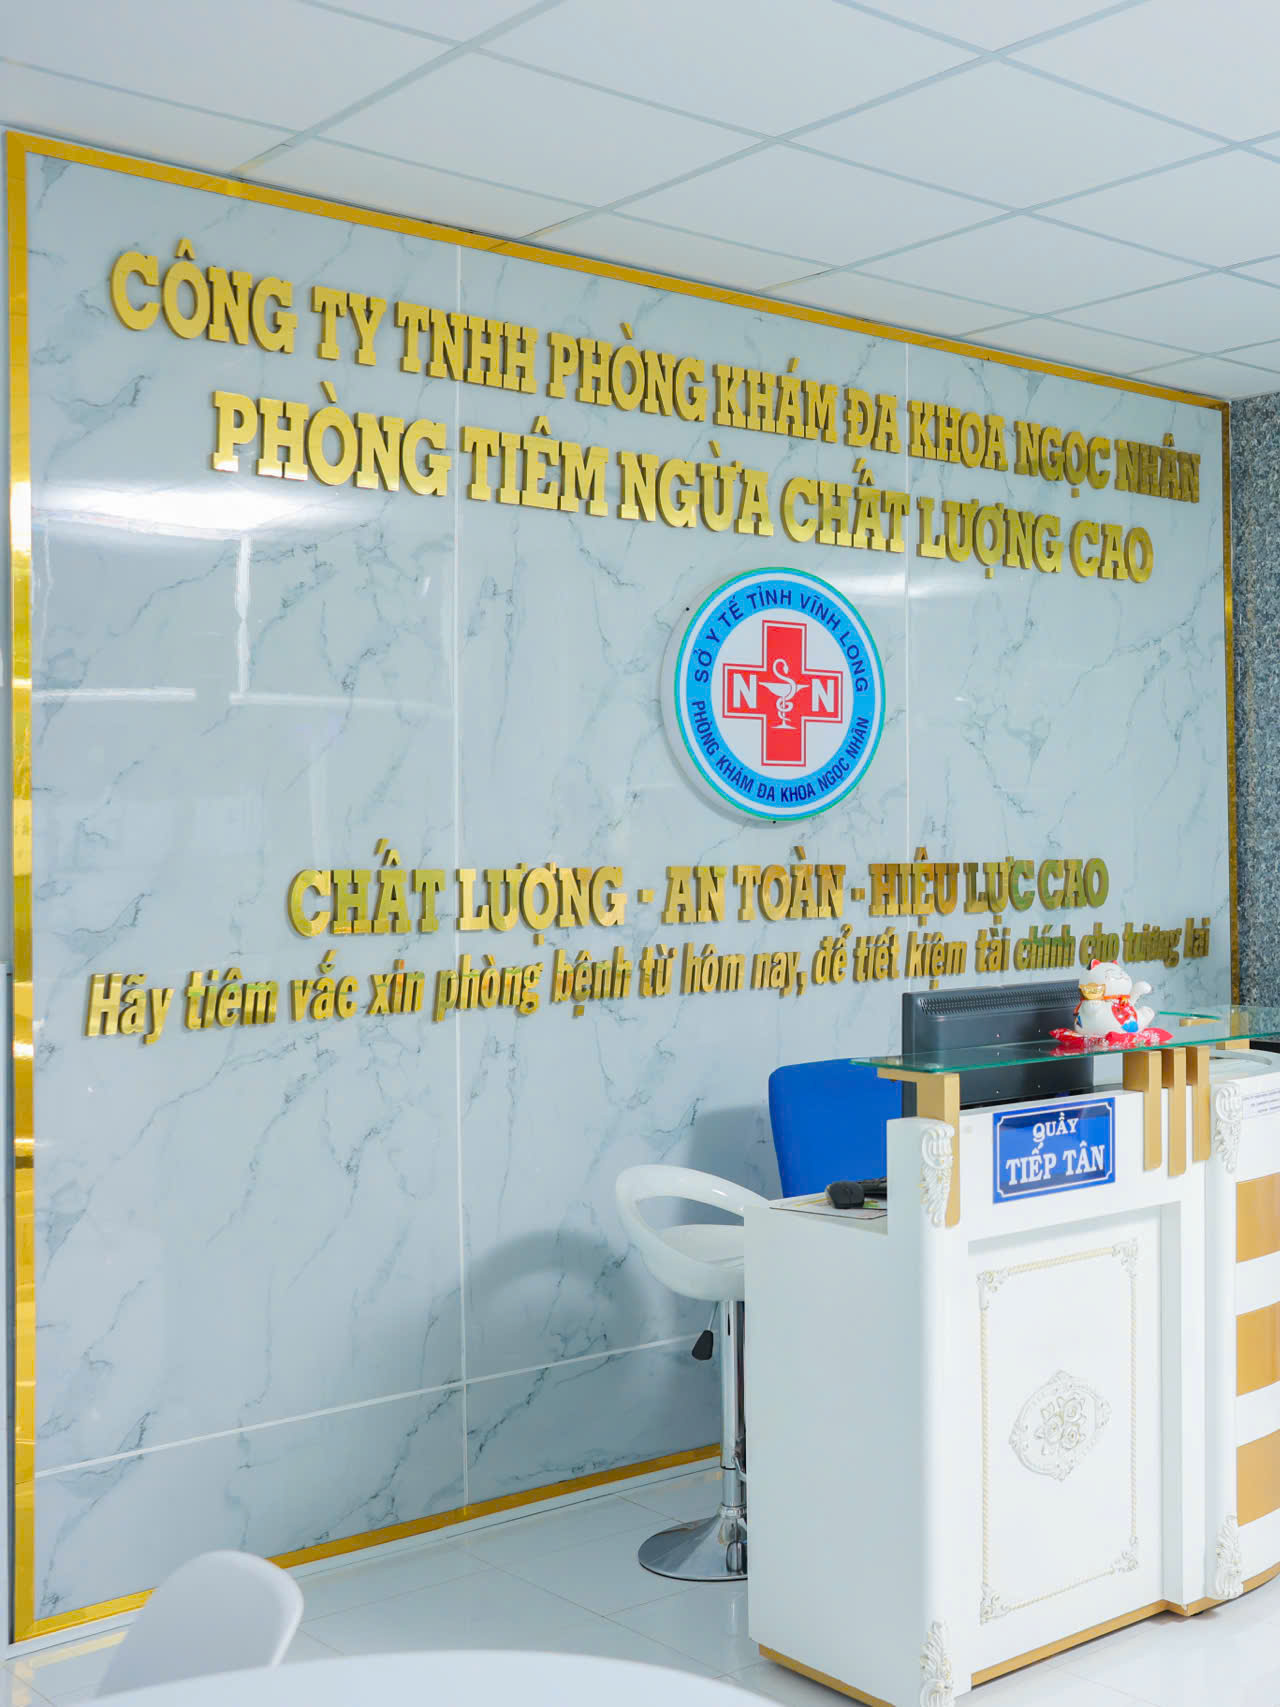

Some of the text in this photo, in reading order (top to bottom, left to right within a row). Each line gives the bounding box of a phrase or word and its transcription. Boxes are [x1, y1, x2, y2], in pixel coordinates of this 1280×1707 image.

[110, 239, 1201, 503] CÔNG TY TNHH PHÒNG KHÁM ĐA KHOA NGỌC NHÂN
[211, 381, 1155, 583] PHÒNG TIÊM NGỪA CHẤT LƯỢNG CAO
[694, 586, 869, 693] SỞ Y TẾ TỈNH VĨNH LONG
[732, 673, 835, 713] N N
[691, 700, 870, 803] PHÒNG KHÁM ĐA KHOA NGỌC NHÂN
[287, 838, 446, 938] CHẤT
[456, 862, 628, 945] LƯỢNG
[661, 864, 728, 924] AN
[733, 846, 847, 922] TOÀN
[868, 846, 960, 927] HIỆU
[964, 857, 1036, 925] LỰC
[1037, 857, 1110, 912] CAO
[84, 972, 175, 1045] Hãy
[184, 967, 279, 1030] tiêm
[290, 949, 359, 1022] vắc
[367, 959, 425, 1017] xin
[434, 954, 544, 1023] phòng
[550, 946, 633, 1017] bệnh
[638, 943, 677, 998] từ
[681, 942, 745, 995] hôm
[752, 949, 808, 997] nay,
[811, 923, 848, 985] để
[853, 925, 900, 983] tiết
[905, 931, 968, 990] kiệm
[974, 927, 1011, 975] tài
[1013, 923, 1076, 971] chính
[1079, 922, 1120, 966] cho
[1183, 917, 1212, 959] lai
[1005, 1140, 1106, 1186] TIẾP TÂN
[1032, 1112, 1079, 1143] QUẦY
